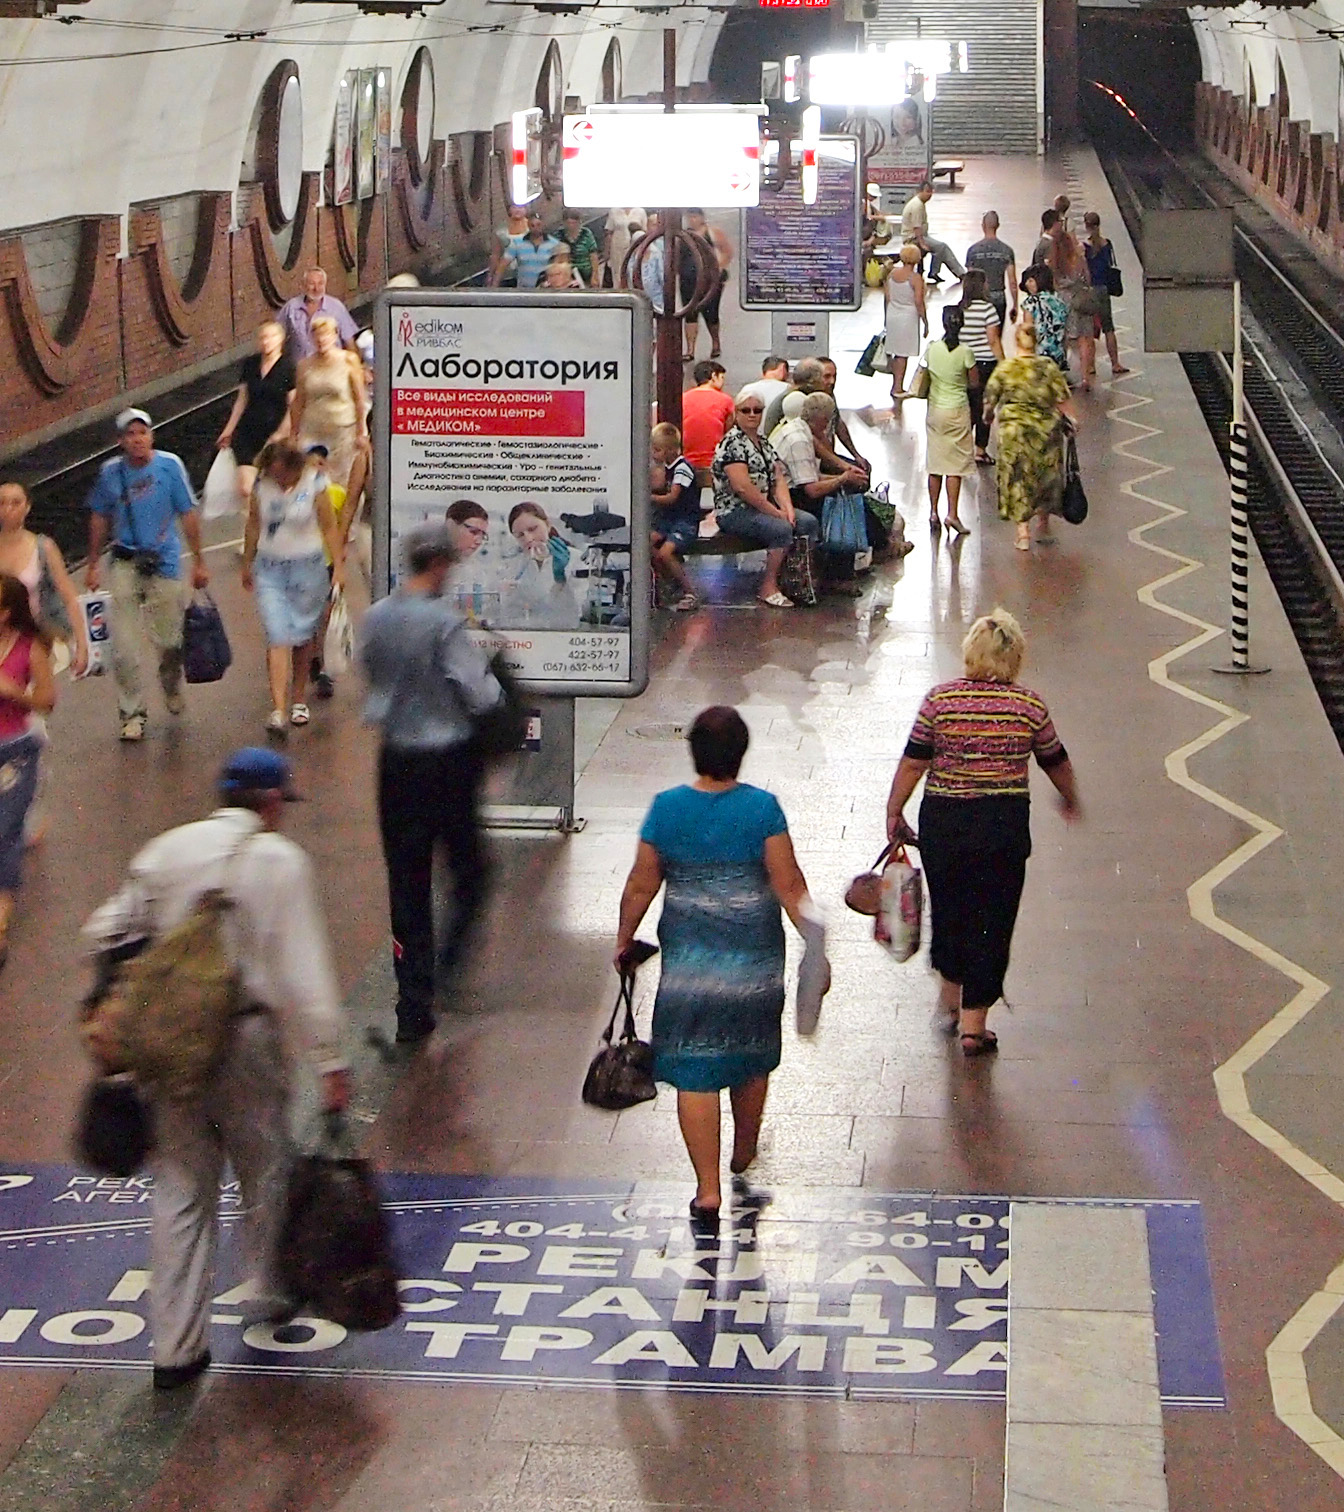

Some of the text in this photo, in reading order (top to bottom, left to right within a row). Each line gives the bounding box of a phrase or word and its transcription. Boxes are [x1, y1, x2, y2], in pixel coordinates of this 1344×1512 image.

[396, 353, 618, 385] Лаборатория
[397, 390, 553, 404] Все виды исследований
[397, 407, 546, 420] в медицинском центре
[442, 1242, 1010, 1289] РЕКЛАМ
[398, 1278, 1010, 1335] СТАНЦІЯ
[404, 1321, 1010, 1376] ТРАМВА
